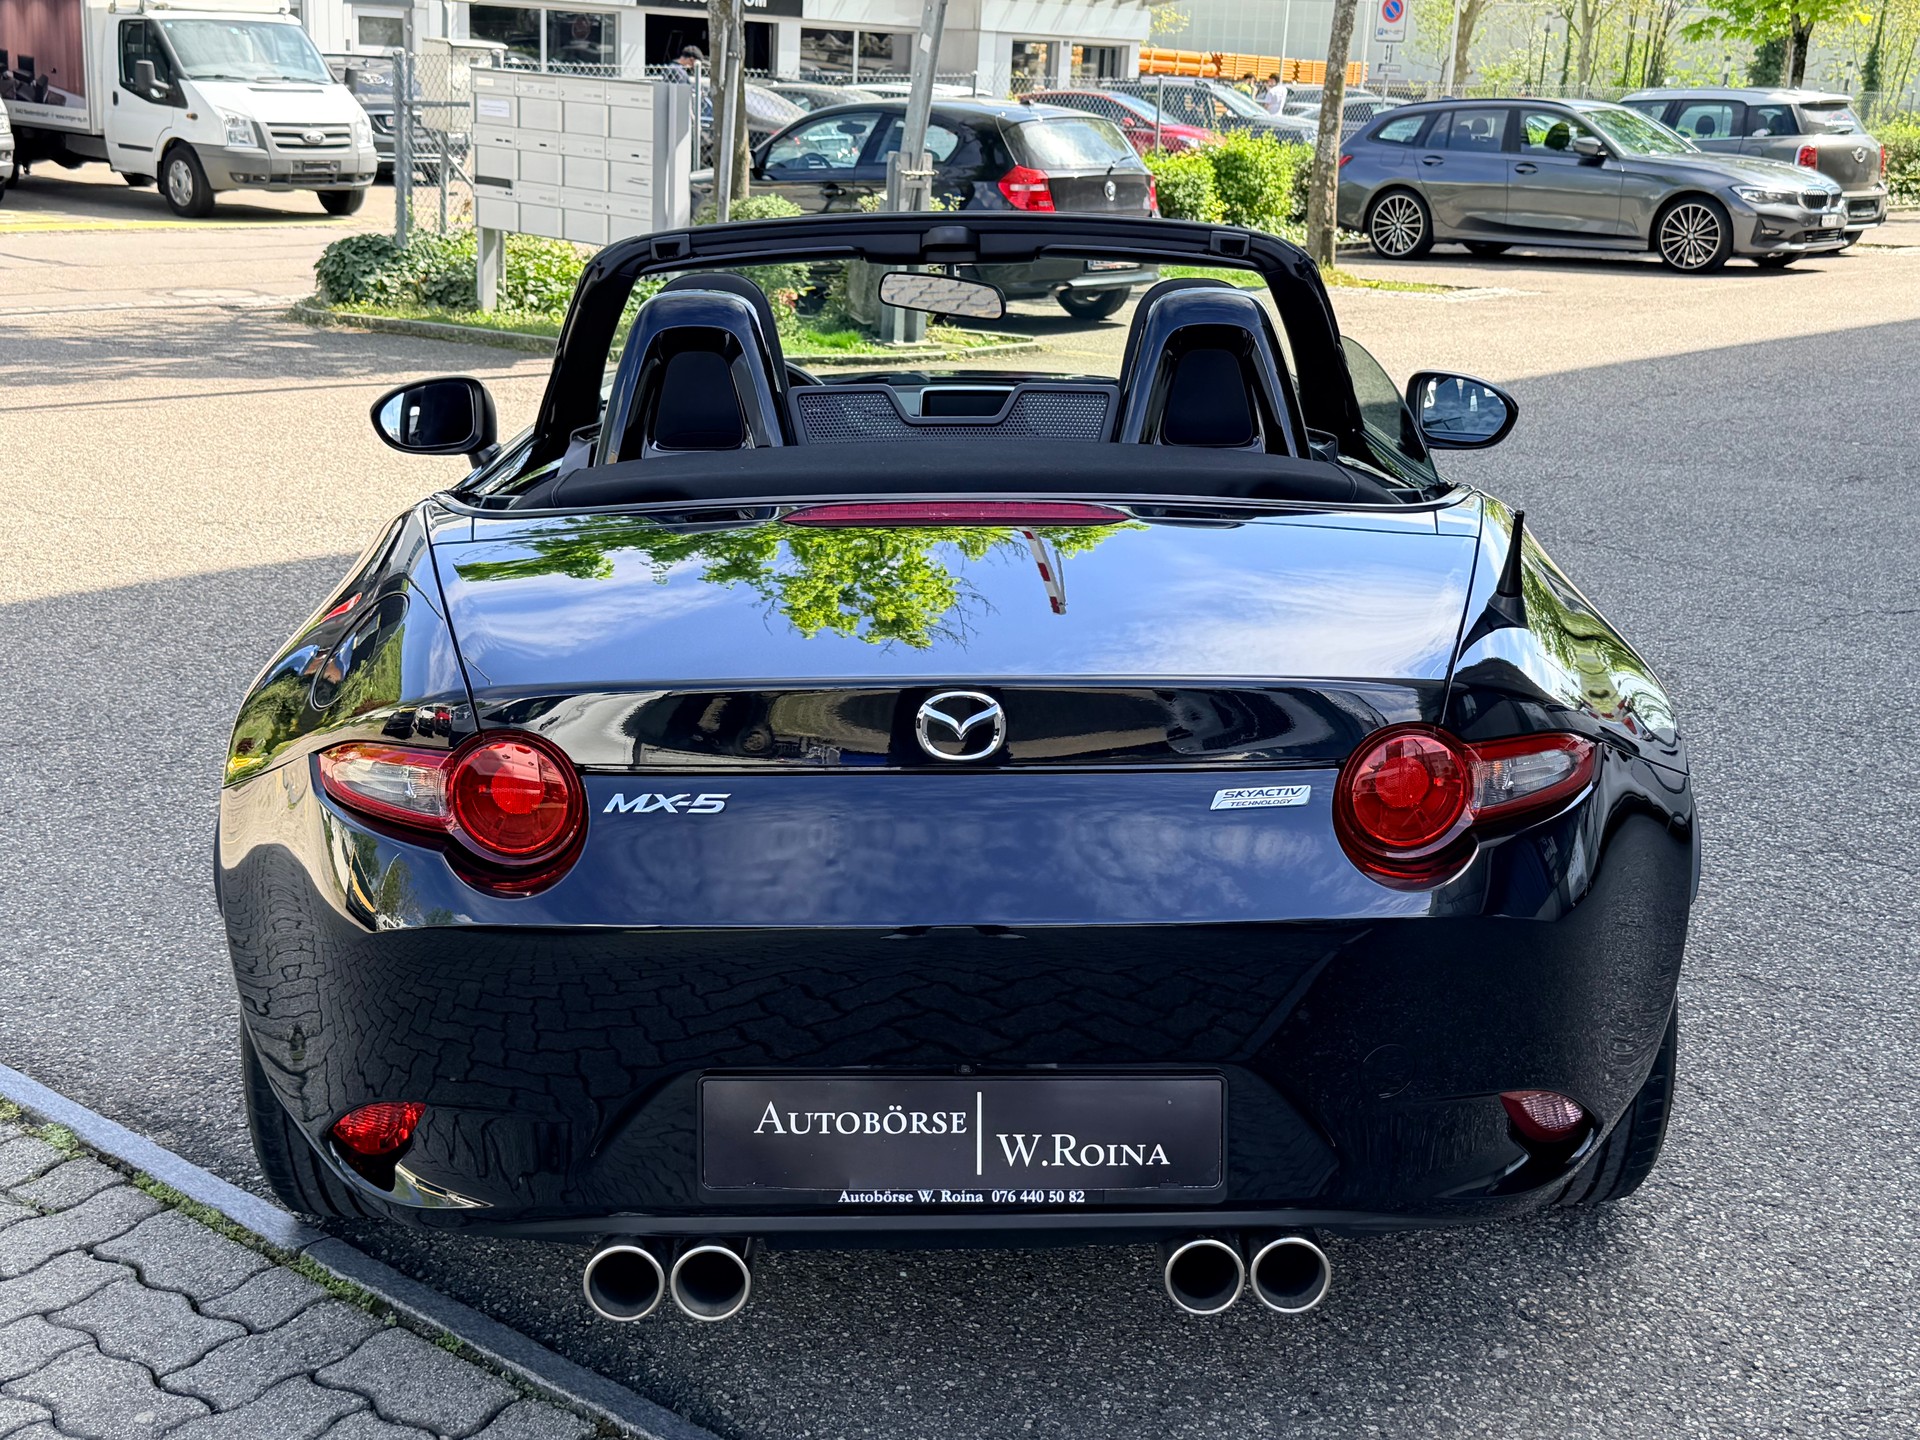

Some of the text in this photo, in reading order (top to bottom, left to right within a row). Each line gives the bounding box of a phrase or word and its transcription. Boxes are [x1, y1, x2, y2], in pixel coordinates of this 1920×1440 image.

[1223, 788, 1302, 799] SKYACTIV
[603, 793, 731, 814] MX-5
[1230, 799, 1293, 807] TECHNOLOGY
[753, 1100, 968, 1135] AUTOBÖRSE
[838, 1190, 1086, 1203] Autobörse W. Roina 076 440 50 82
